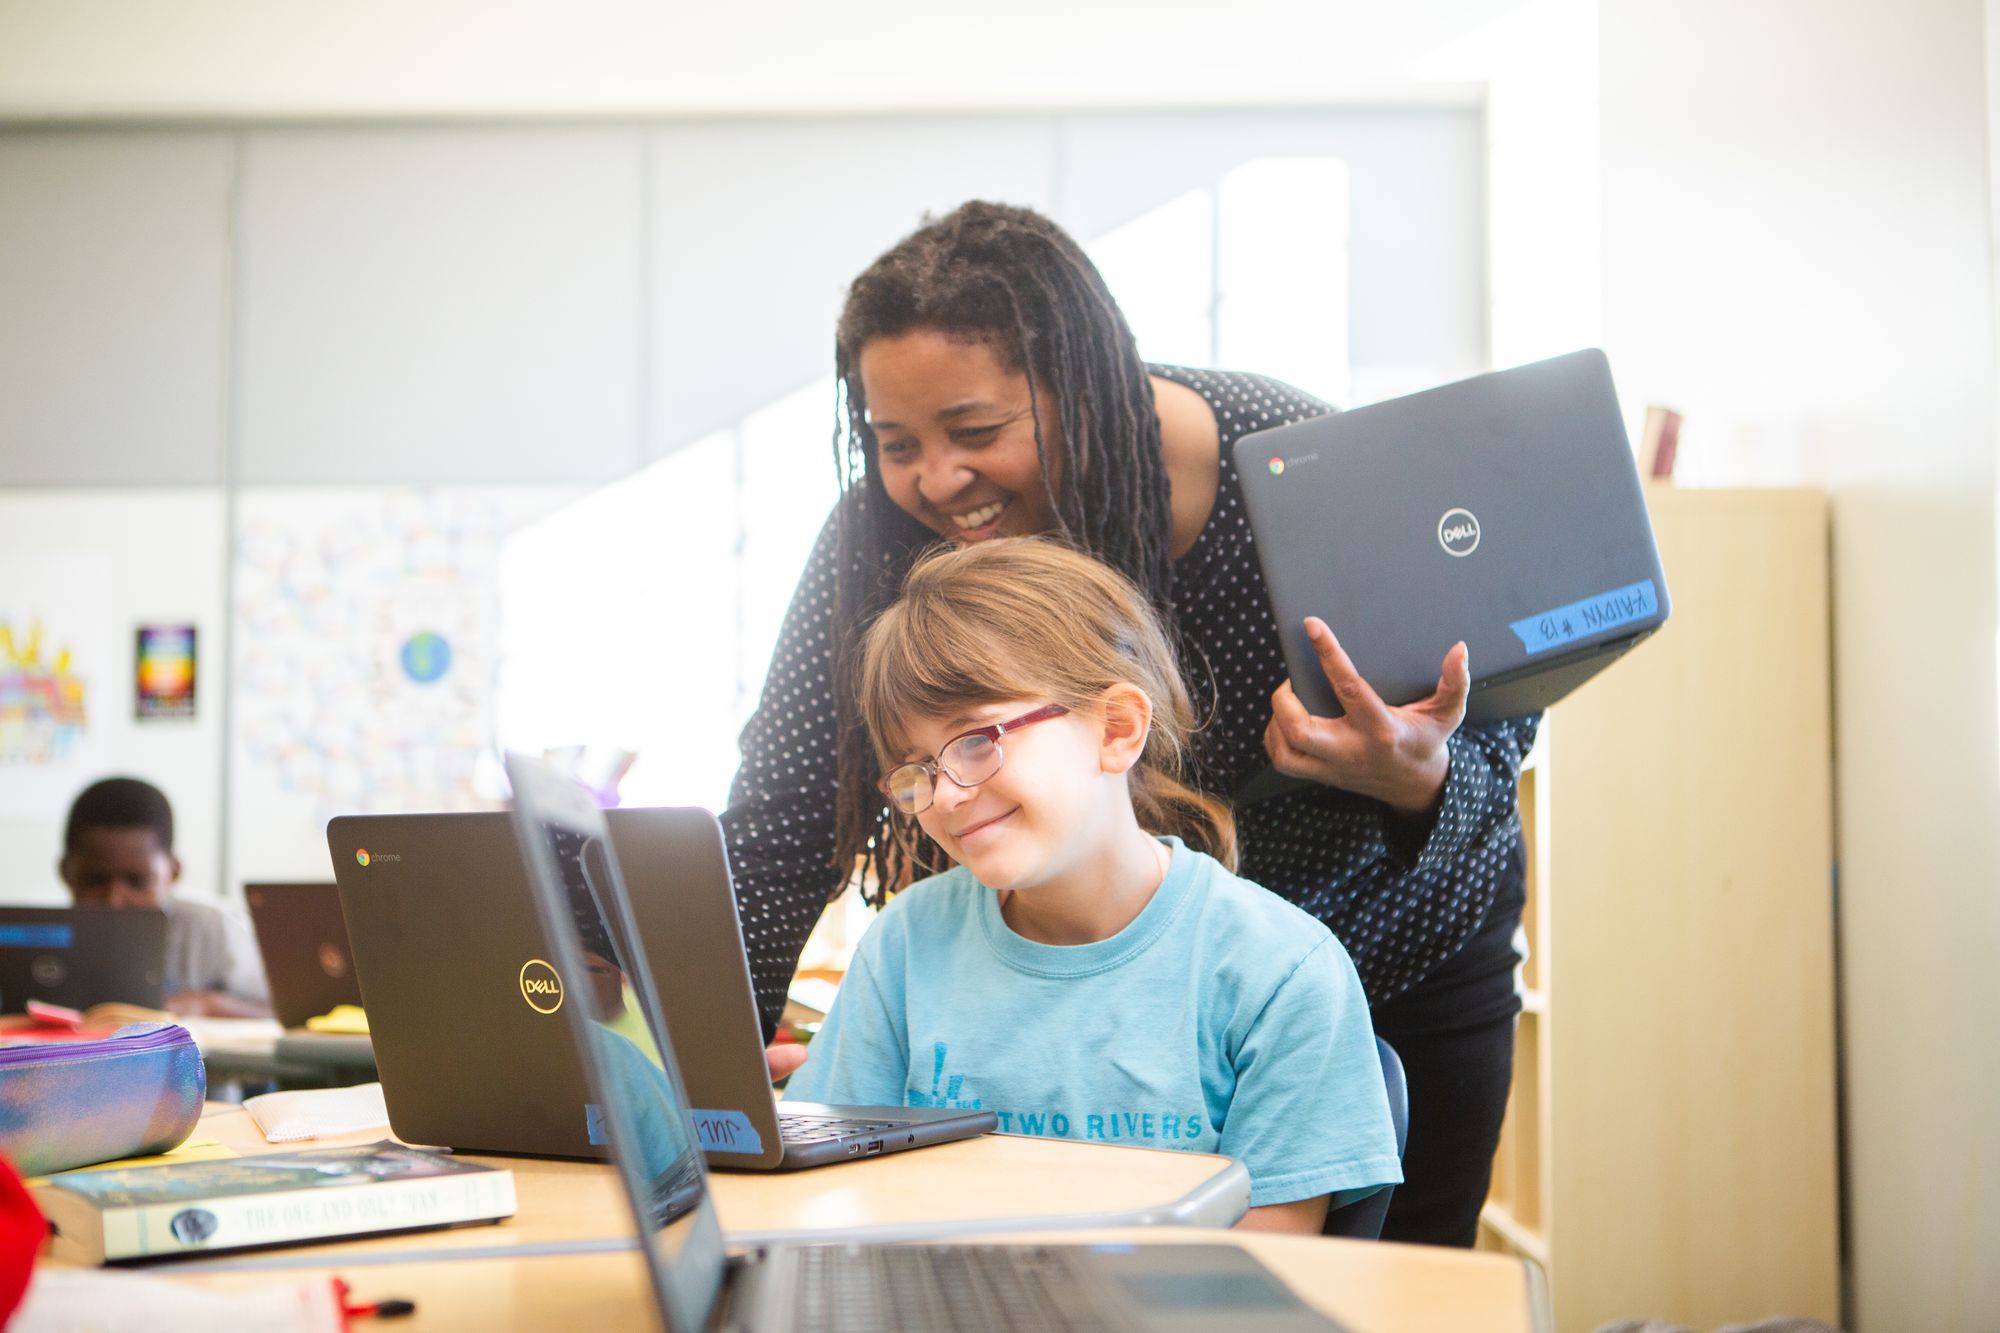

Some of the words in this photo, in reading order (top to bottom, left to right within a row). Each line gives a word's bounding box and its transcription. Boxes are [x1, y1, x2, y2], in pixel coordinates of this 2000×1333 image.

[1287, 452, 1319, 468] chrome
[1443, 522, 1477, 544] DELL
[1582, 588, 1648, 628] KAIDYN
[371, 852, 401, 862] chrome
[525, 979, 560, 994] DELL
[692, 1116, 740, 1145] JULI
[998, 1111, 1070, 1136] TWO
[1087, 1111, 1203, 1139] RIVERS
[244, 1205, 277, 1232] THE
[282, 1201, 315, 1226] ONE
[321, 1197, 352, 1221] AND
